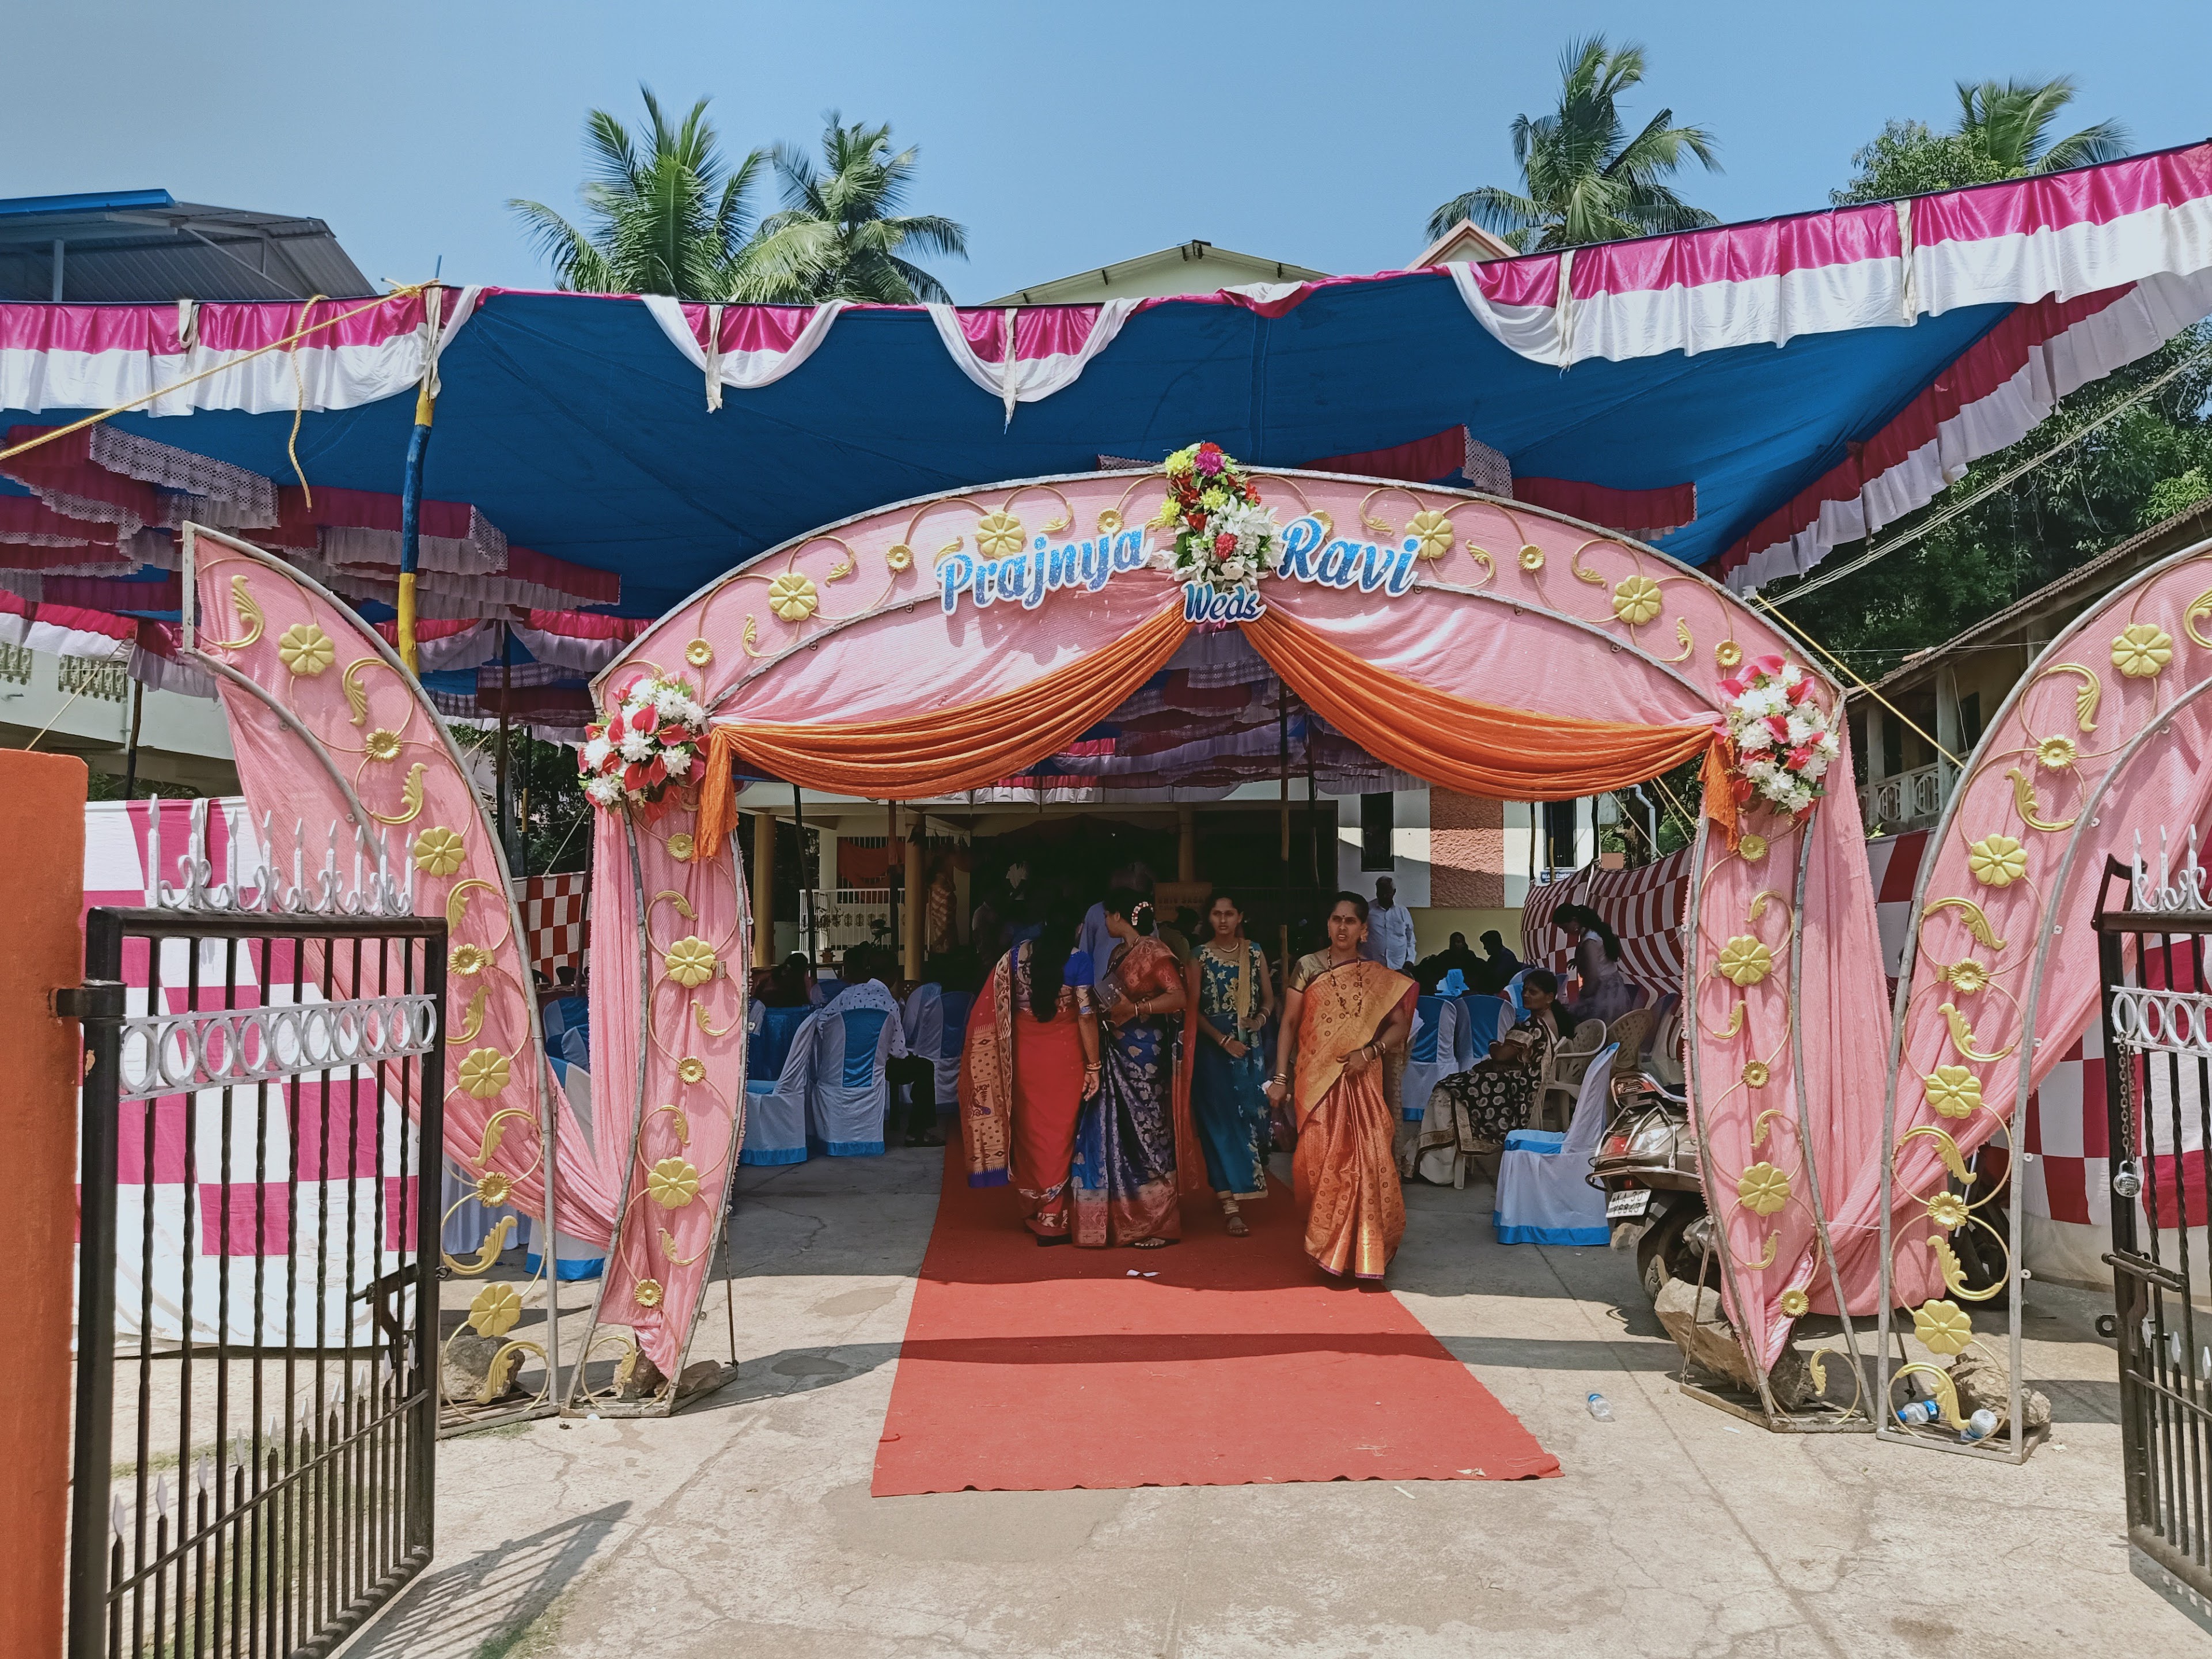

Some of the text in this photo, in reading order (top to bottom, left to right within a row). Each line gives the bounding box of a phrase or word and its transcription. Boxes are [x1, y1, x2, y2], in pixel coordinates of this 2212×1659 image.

[936, 517, 1419, 622] Prajnya Weds Ravi
[1615, 1191, 1645, 1203] KA 30
